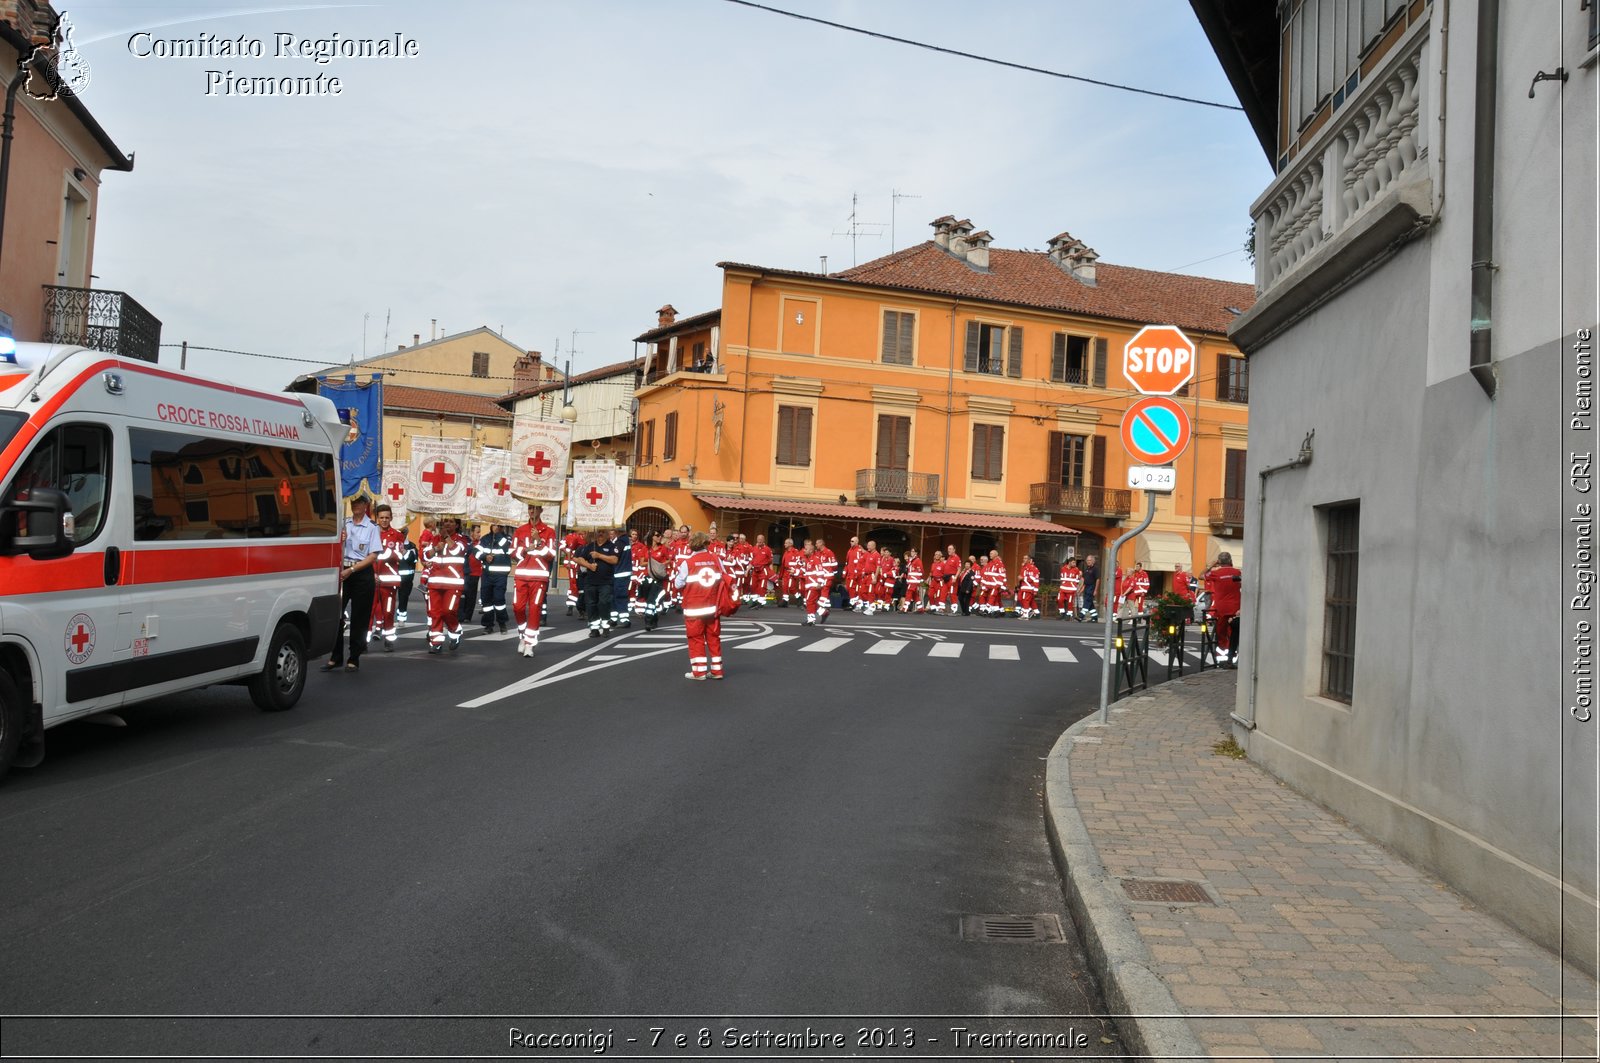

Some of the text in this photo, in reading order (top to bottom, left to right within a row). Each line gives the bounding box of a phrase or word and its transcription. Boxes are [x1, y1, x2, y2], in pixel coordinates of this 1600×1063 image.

[1129, 347, 1190, 374] STOP
[157, 403, 300, 440] CROCE ROSSA ITALIANA
[824, 628, 948, 642] STOP
